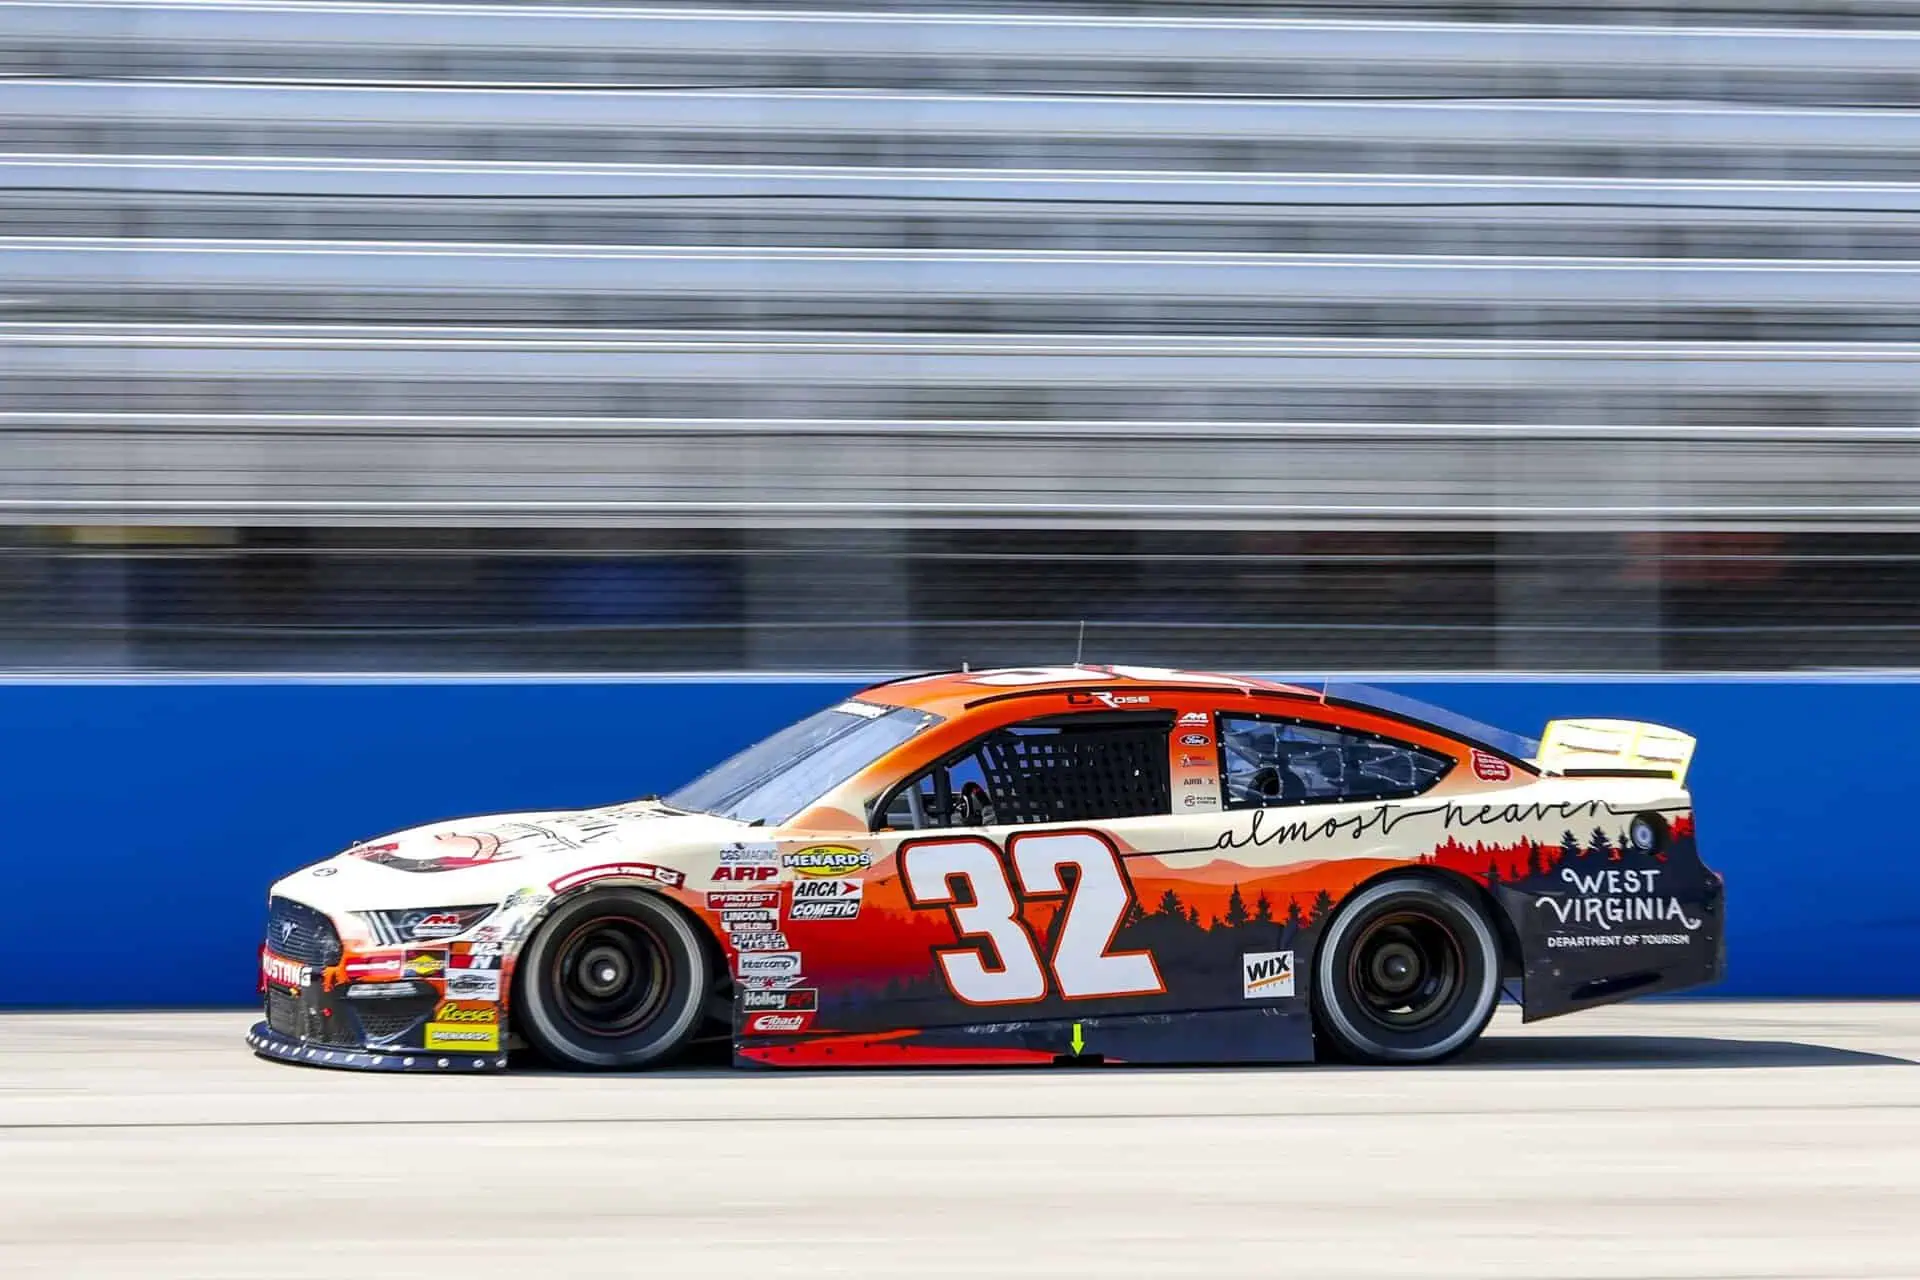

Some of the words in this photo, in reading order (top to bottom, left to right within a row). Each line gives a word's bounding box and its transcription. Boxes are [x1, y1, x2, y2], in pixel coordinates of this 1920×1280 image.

[1208, 804, 1400, 850] almost
[783, 854, 871, 867] MENARDS
[711, 866, 778, 881] ARP
[1561, 868, 1660, 894] WEST
[795, 881, 838, 897] ARCA
[710, 893, 776, 902] PYROTECT
[792, 902, 858, 917] COMETIC
[897, 828, 1167, 1006] 32
[1535, 896, 1701, 930] VIRGINIA
[1548, 936, 1621, 947] DEPARTMENT
[1624, 936, 1639, 946] OF
[1642, 935, 1690, 944] TOURISM
[1246, 954, 1289, 982] WIX
[744, 992, 786, 1008] Holley
